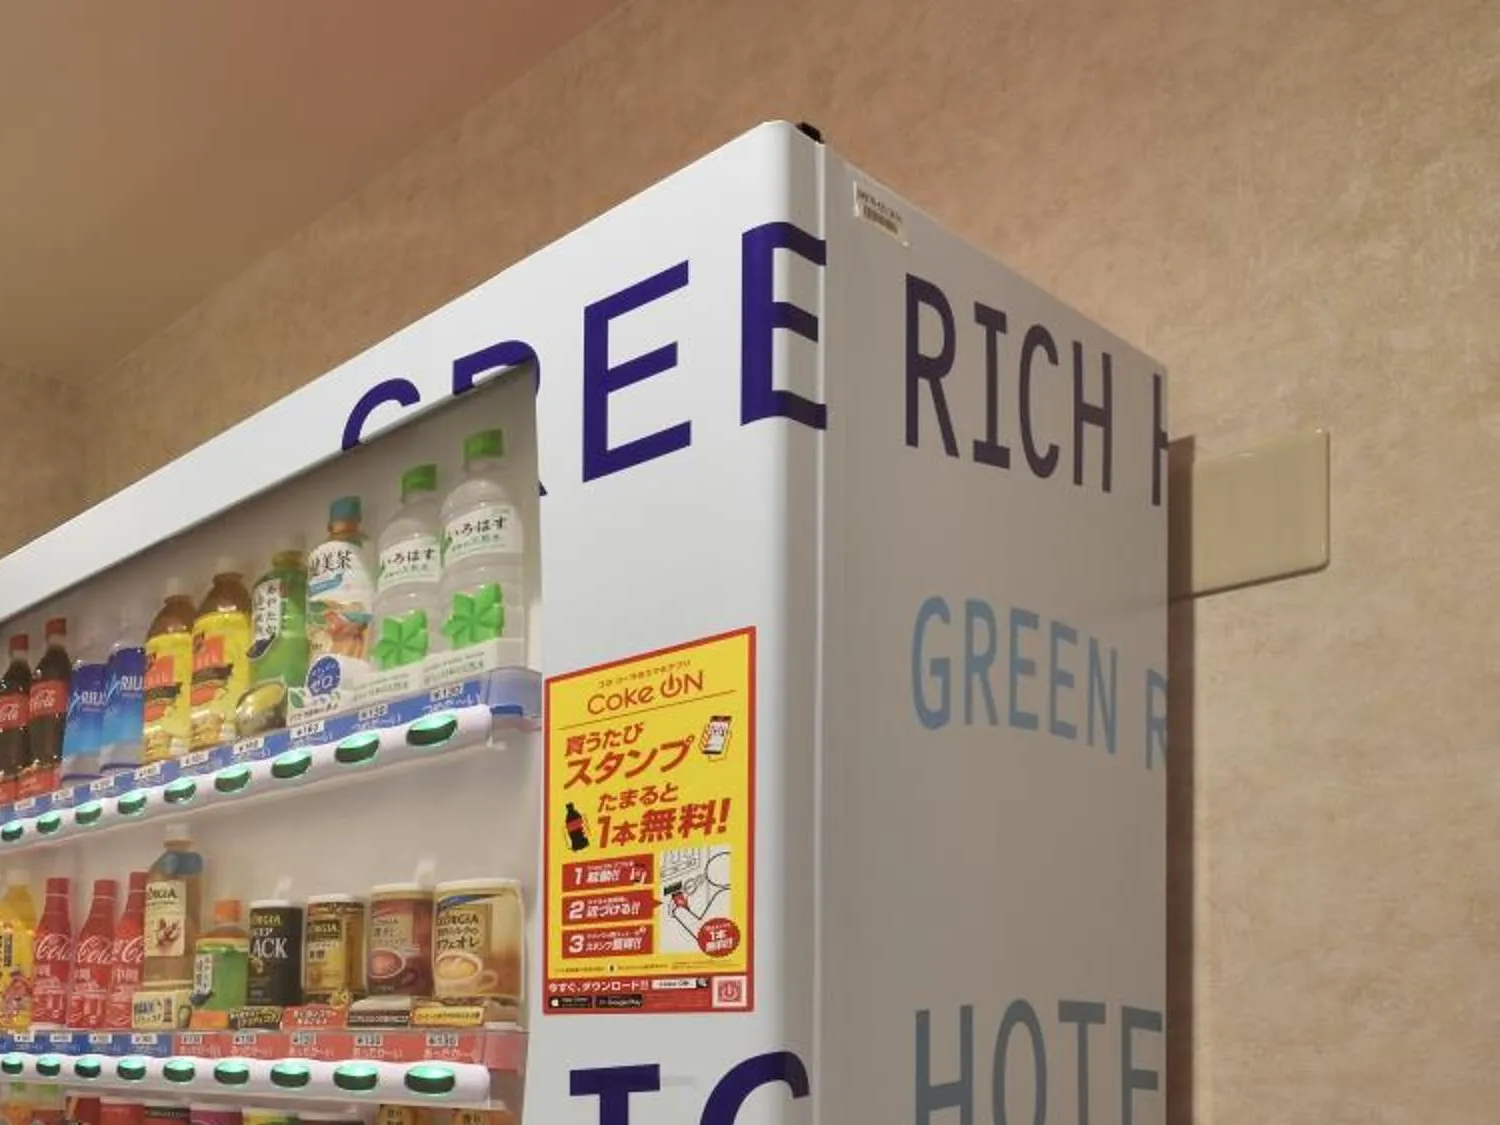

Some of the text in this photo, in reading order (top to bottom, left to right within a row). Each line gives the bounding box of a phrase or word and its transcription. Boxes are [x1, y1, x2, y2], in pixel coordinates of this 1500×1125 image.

[905, 272, 1112, 494] RICH
[911, 595, 1117, 754] GREEN
[587, 685, 655, 715] Coke
[564, 721, 645, 756] 買うたび
[563, 734, 696, 790] スタンプ
[598, 782, 679, 813] たまると
[569, 901, 585, 920] 2
[569, 935, 585, 953] 3
